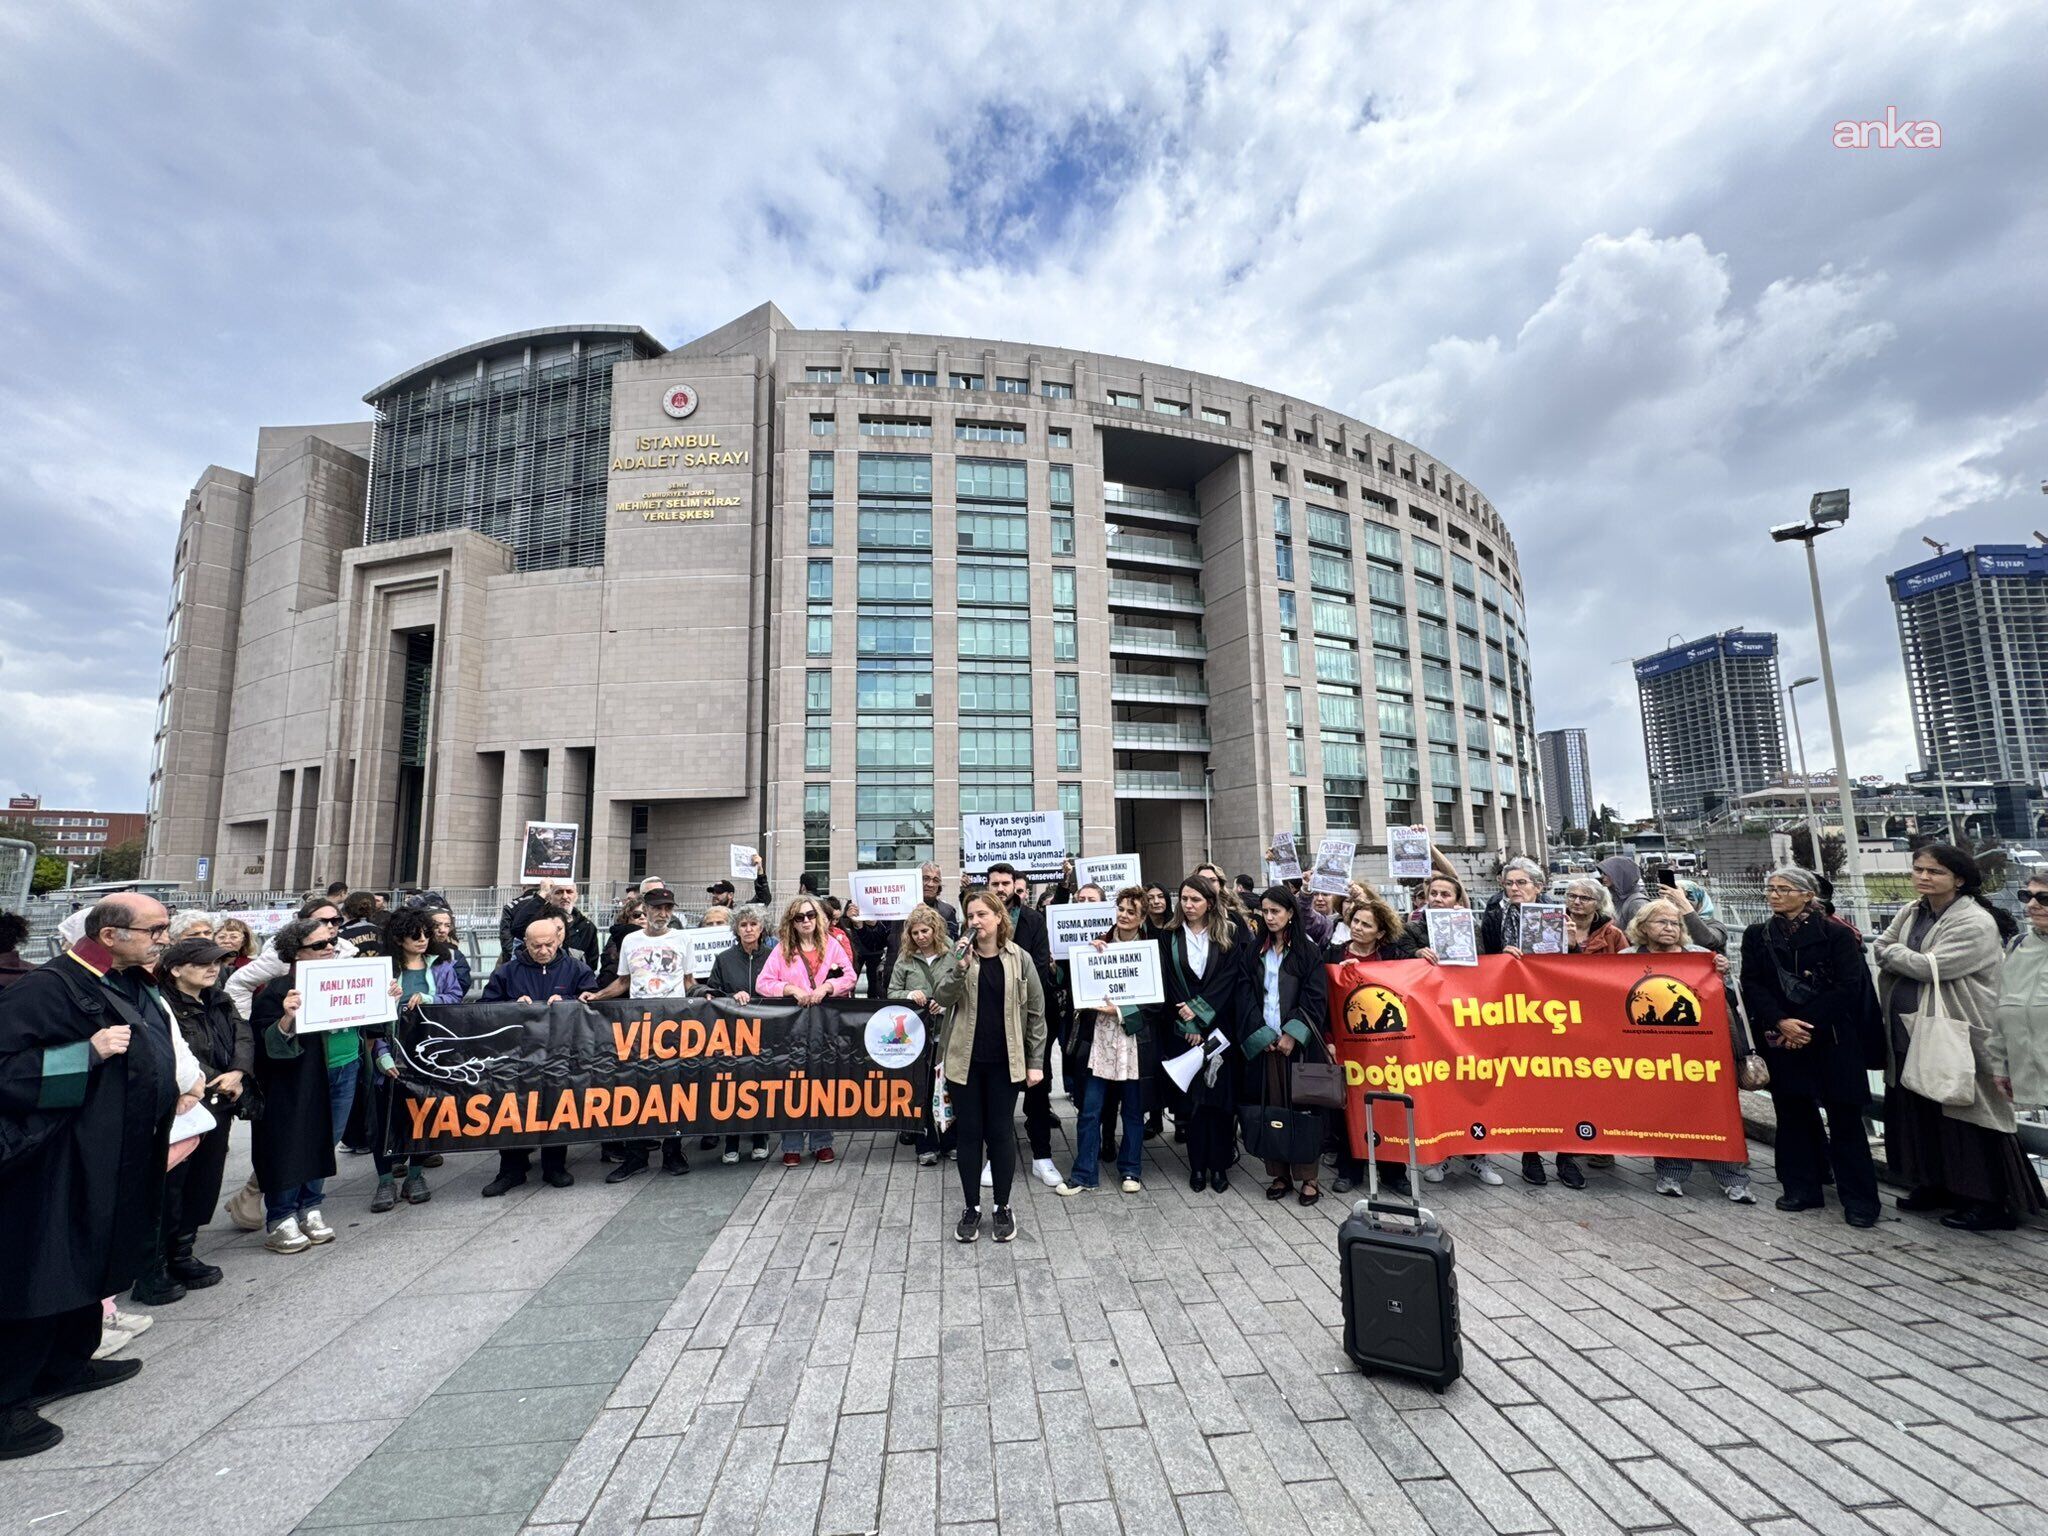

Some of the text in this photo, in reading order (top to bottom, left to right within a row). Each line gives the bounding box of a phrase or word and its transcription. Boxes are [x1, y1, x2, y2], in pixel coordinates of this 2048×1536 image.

[636, 434, 721, 451] İSTANBUL
[612, 450, 749, 471] ADALET SARAYI
[616, 496, 741, 512] MEHMET SELİM KİRAZ
[979, 813, 1046, 827] Hayvan sevgisini
[994, 827, 1032, 838] tatmayan
[975, 838, 1052, 850] bir insanın ruhunun
[965, 848, 1065, 862] bir bölümü asla uyanmaz!
[1030, 861, 1063, 869] Schopenhaue
[1087, 862, 1127, 873] HAYVAN HAKKI
[864, 883, 906, 894] KANLI YASAYI
[873, 896, 901, 906] İPTAL ET!
[1060, 932, 1078, 942] KORU
[1080, 932, 1088, 941] VE
[1088, 952, 1142, 966] HAYVAN HAKKI
[1093, 966, 1139, 980] İHLALLERİNE
[320, 977, 373, 991] KANLI YASAYI
[1108, 983, 1126, 993] SON!
[330, 993, 366, 1007] İPTAL ET!
[1452, 993, 1582, 1035] Halkçı
[612, 1012, 762, 1061] VİCDAN
[1455, 1053, 1722, 1087] Hayvanseverler
[405, 1070, 922, 1140] YASALARDAN ÜSTÜNDÜR.
